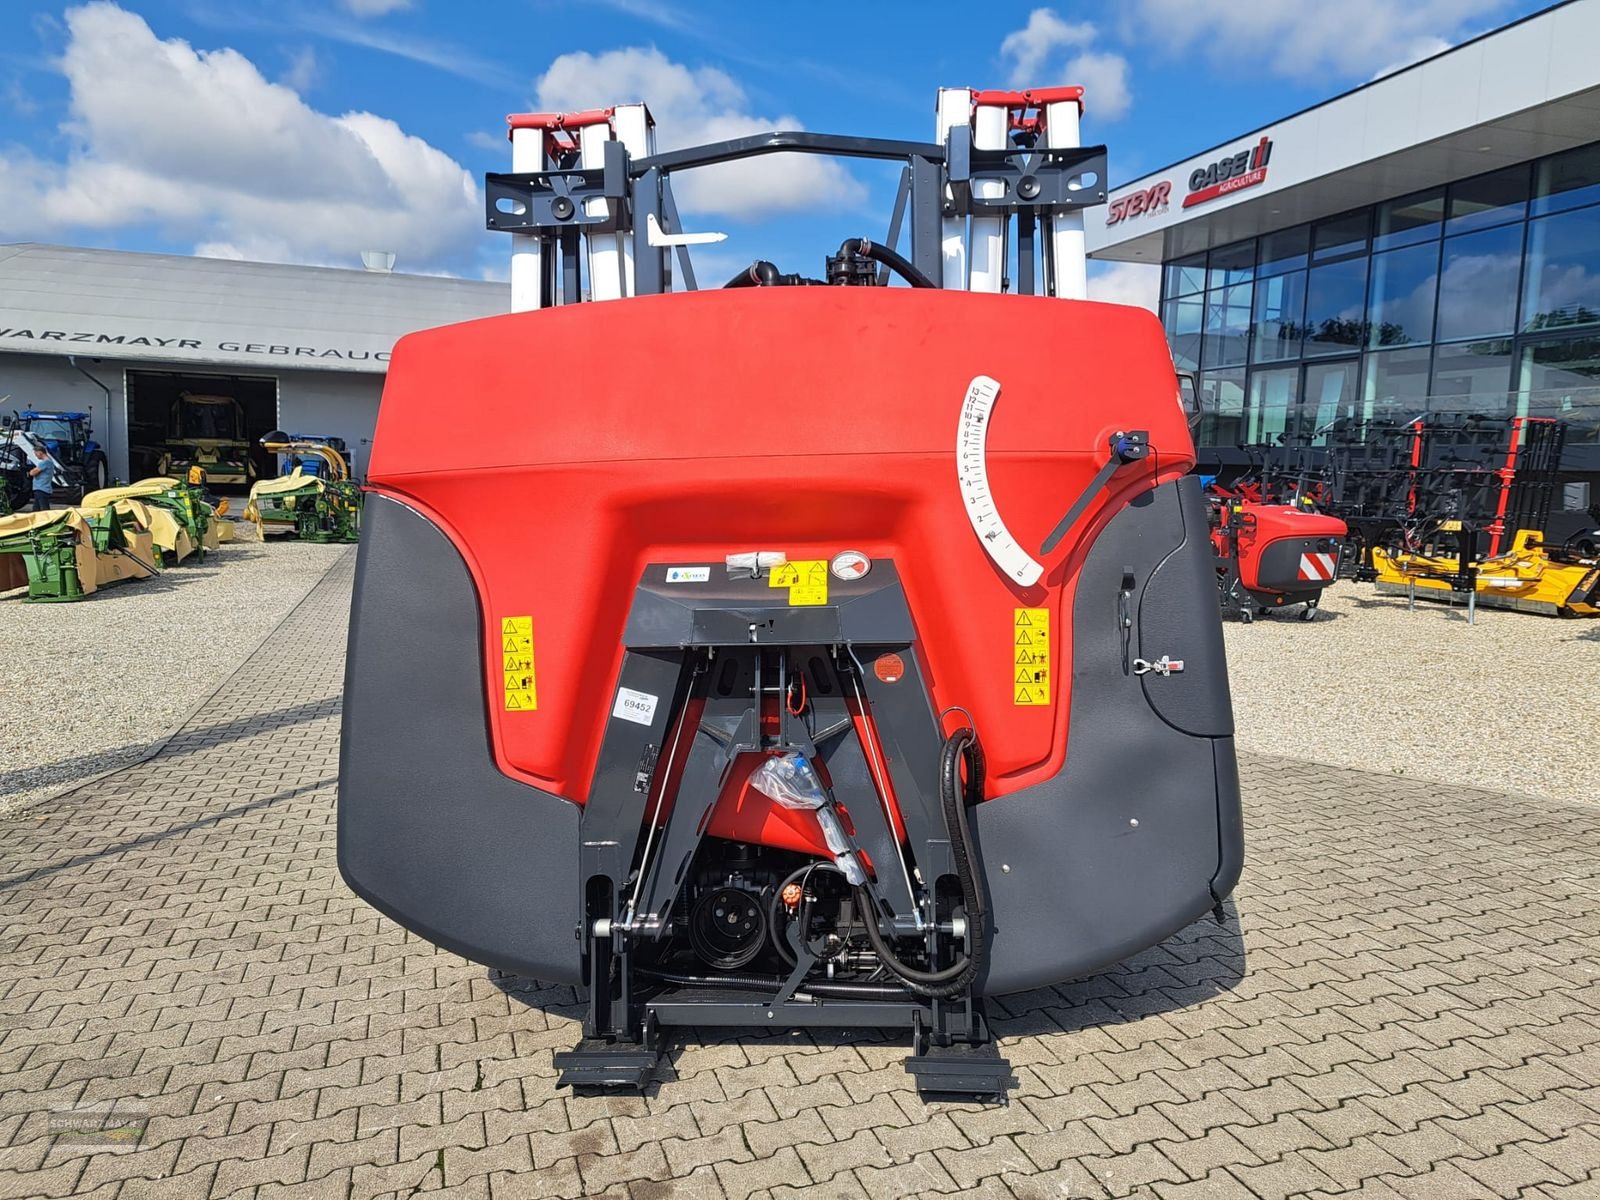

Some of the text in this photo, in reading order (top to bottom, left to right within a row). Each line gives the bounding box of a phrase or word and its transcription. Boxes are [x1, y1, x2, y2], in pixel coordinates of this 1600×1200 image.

[1189, 150, 1249, 191] CASE
[1218, 171, 1264, 194] AGRICULTURE
[1106, 181, 1172, 225] STEYR
[972, 387, 980, 396] 13
[969, 396, 977, 404] 12
[964, 411, 973, 420] 10
[963, 450, 969, 459] 6
[964, 465, 970, 473] 5
[977, 515, 983, 523] 2
[624, 700, 651, 712] 69452
